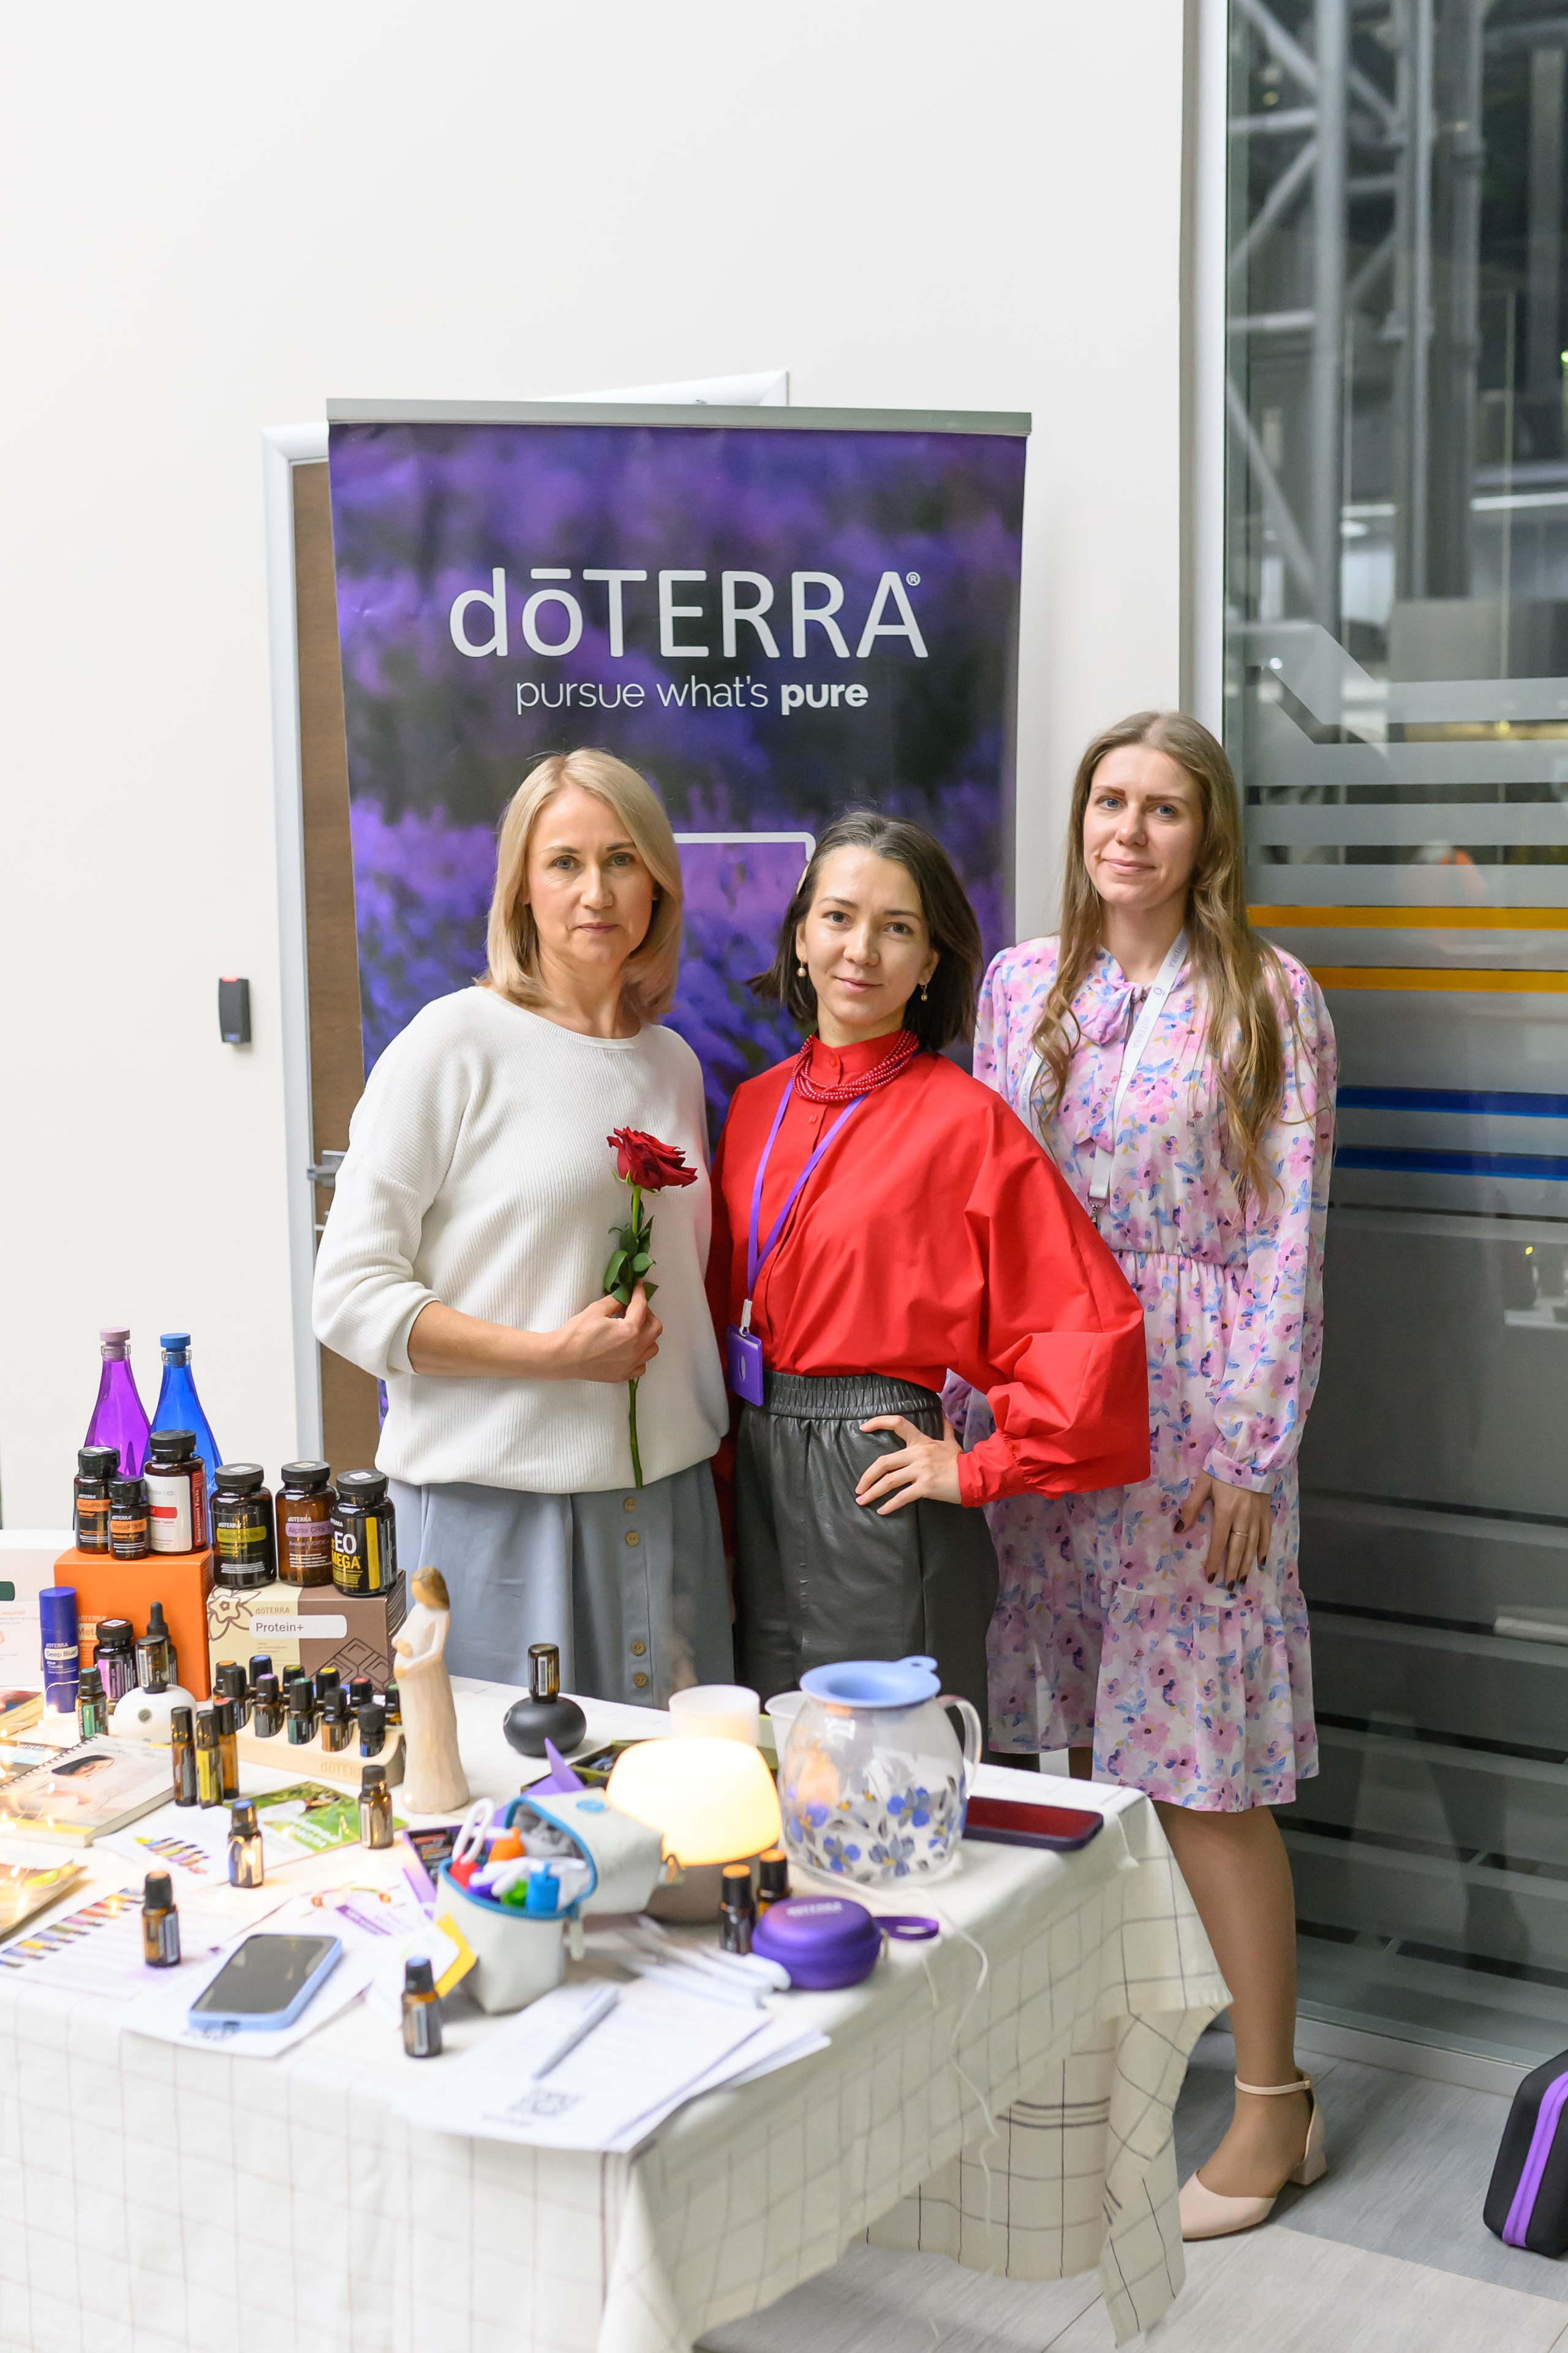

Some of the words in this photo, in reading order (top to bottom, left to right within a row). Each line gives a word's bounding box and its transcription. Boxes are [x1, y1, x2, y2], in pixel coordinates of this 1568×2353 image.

[516, 682, 645, 716] pursue
[781, 682, 869, 716] pure
[256, 1622, 304, 1632] Protein+
